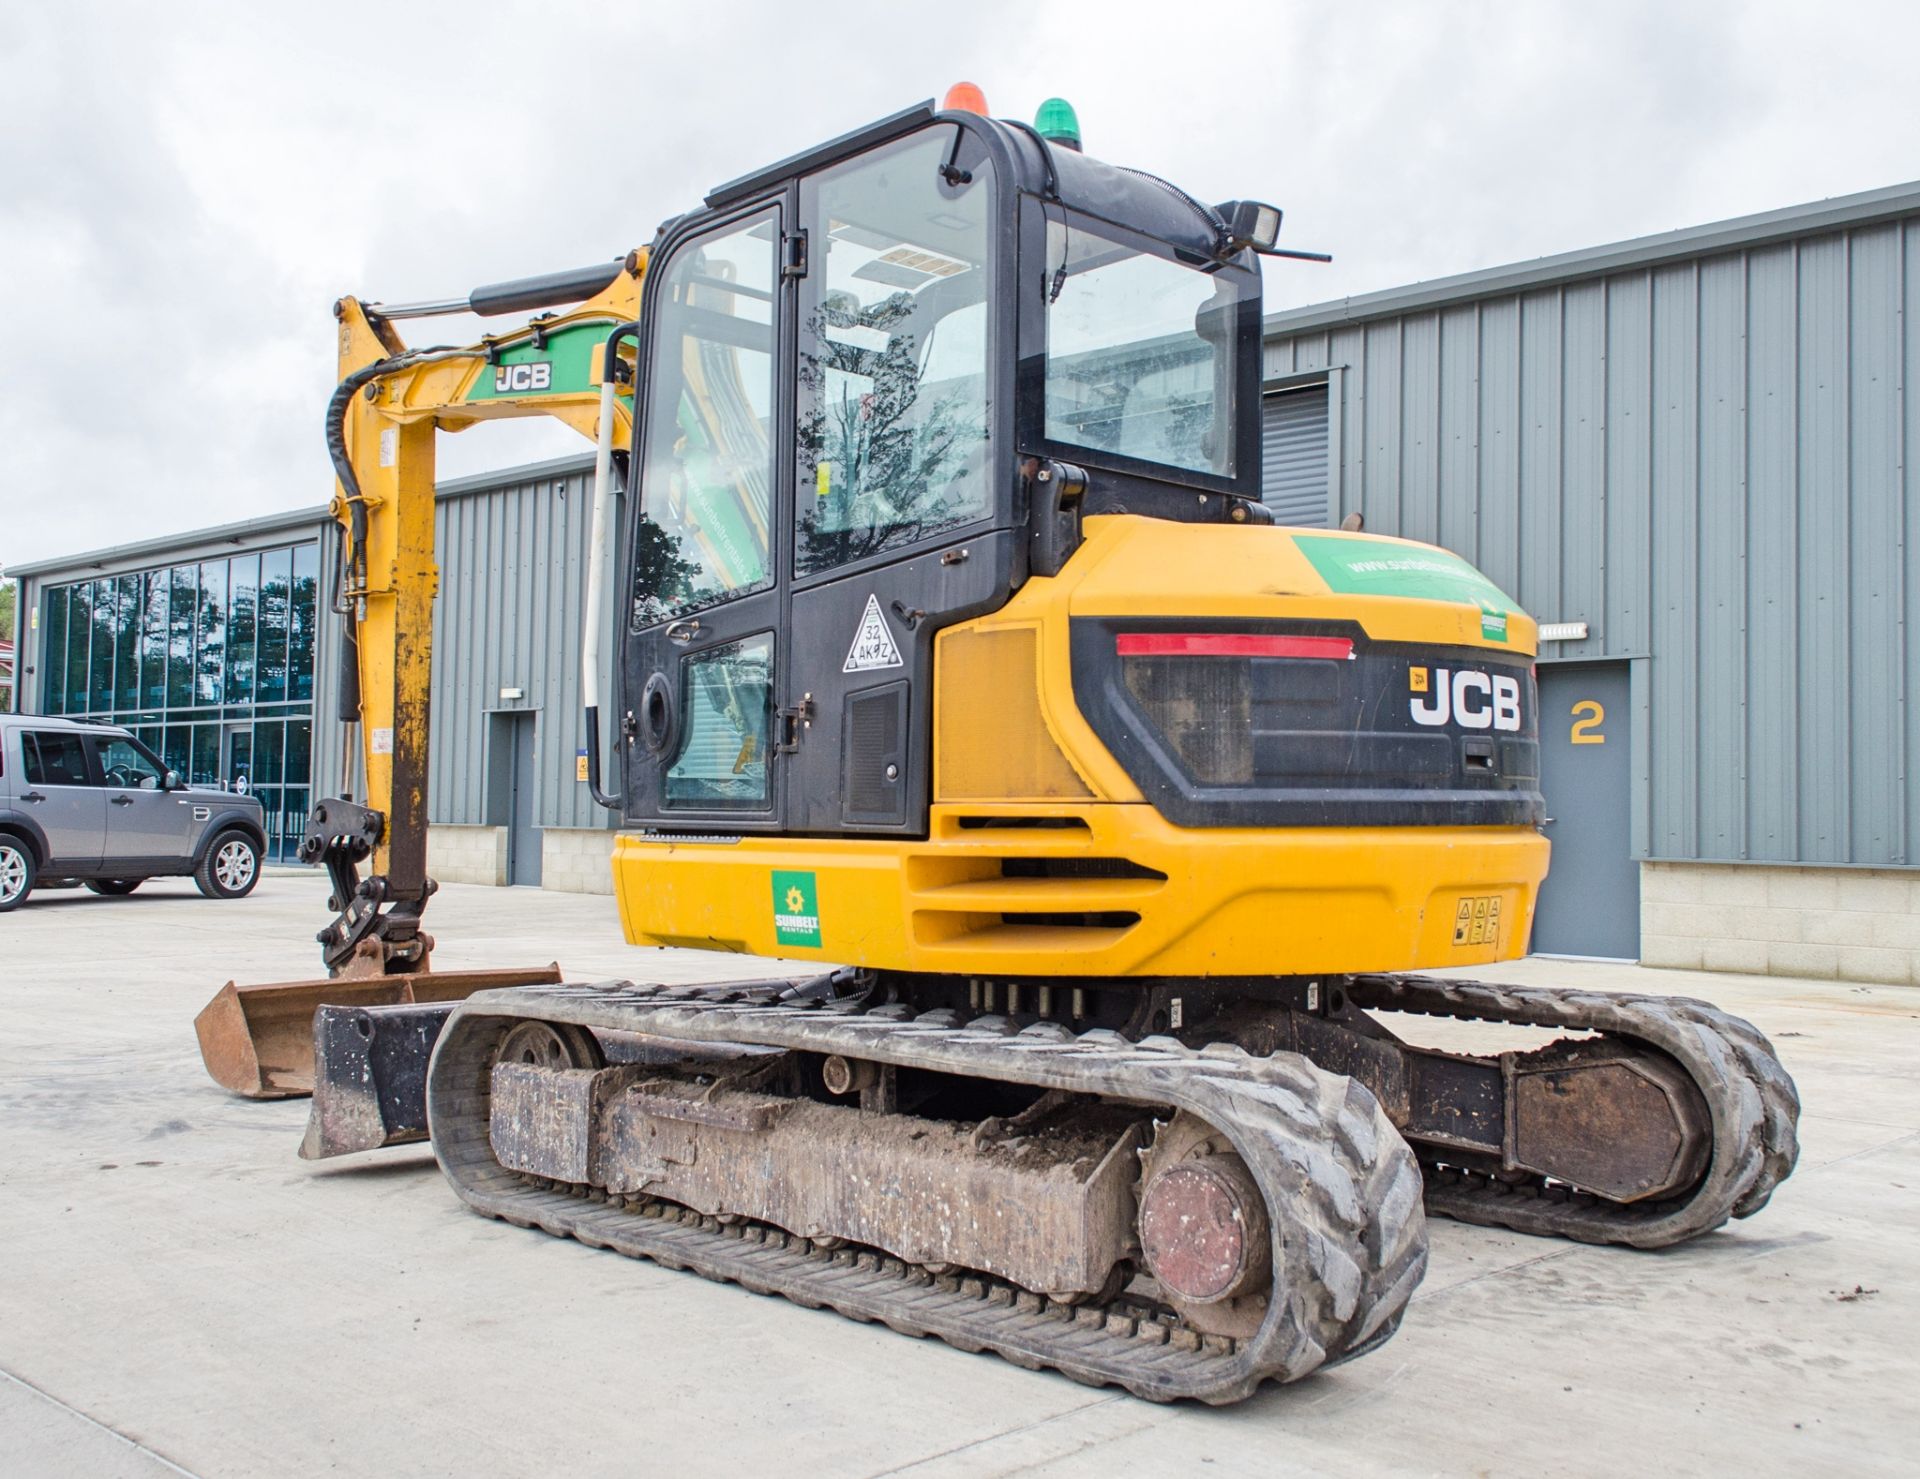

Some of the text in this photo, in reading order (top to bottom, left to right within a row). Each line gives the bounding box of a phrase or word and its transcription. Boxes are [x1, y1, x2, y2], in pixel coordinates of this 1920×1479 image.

[496, 363, 551, 391] JCB
[866, 625, 880, 640] 32
[1410, 668, 1520, 731] JCB
[1571, 700, 1605, 744] 2
[775, 914, 819, 928] SUNBELT
